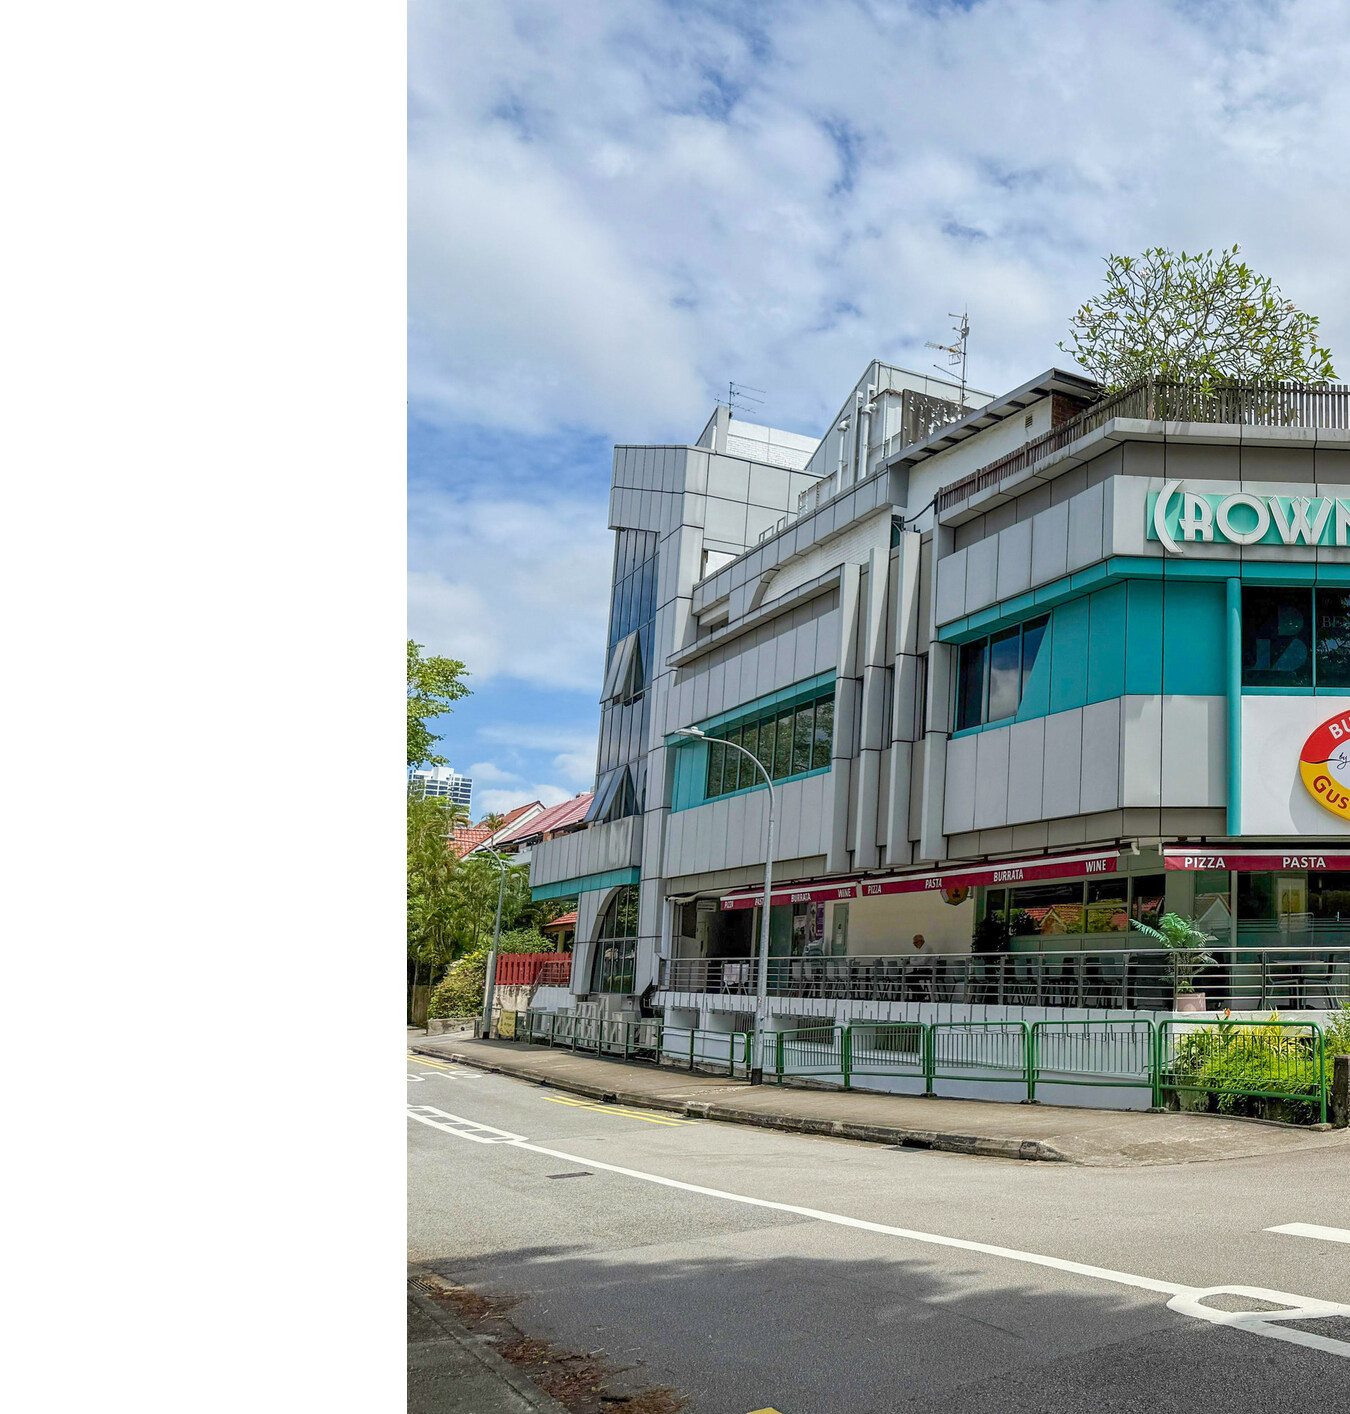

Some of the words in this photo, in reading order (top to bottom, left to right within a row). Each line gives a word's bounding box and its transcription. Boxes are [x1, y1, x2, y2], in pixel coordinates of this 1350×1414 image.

[1337, 752, 1348, 770] by
[1184, 856, 1226, 869] PIZZA
[1282, 856, 1327, 869] PASTA
[867, 884, 882, 895] PIZZA
[925, 878, 943, 889] PASTA
[993, 869, 1024, 883] BURRATA
[1085, 859, 1107, 873] WINE
[755, 897, 765, 906] PAST
[837, 888, 851, 898] WINE
